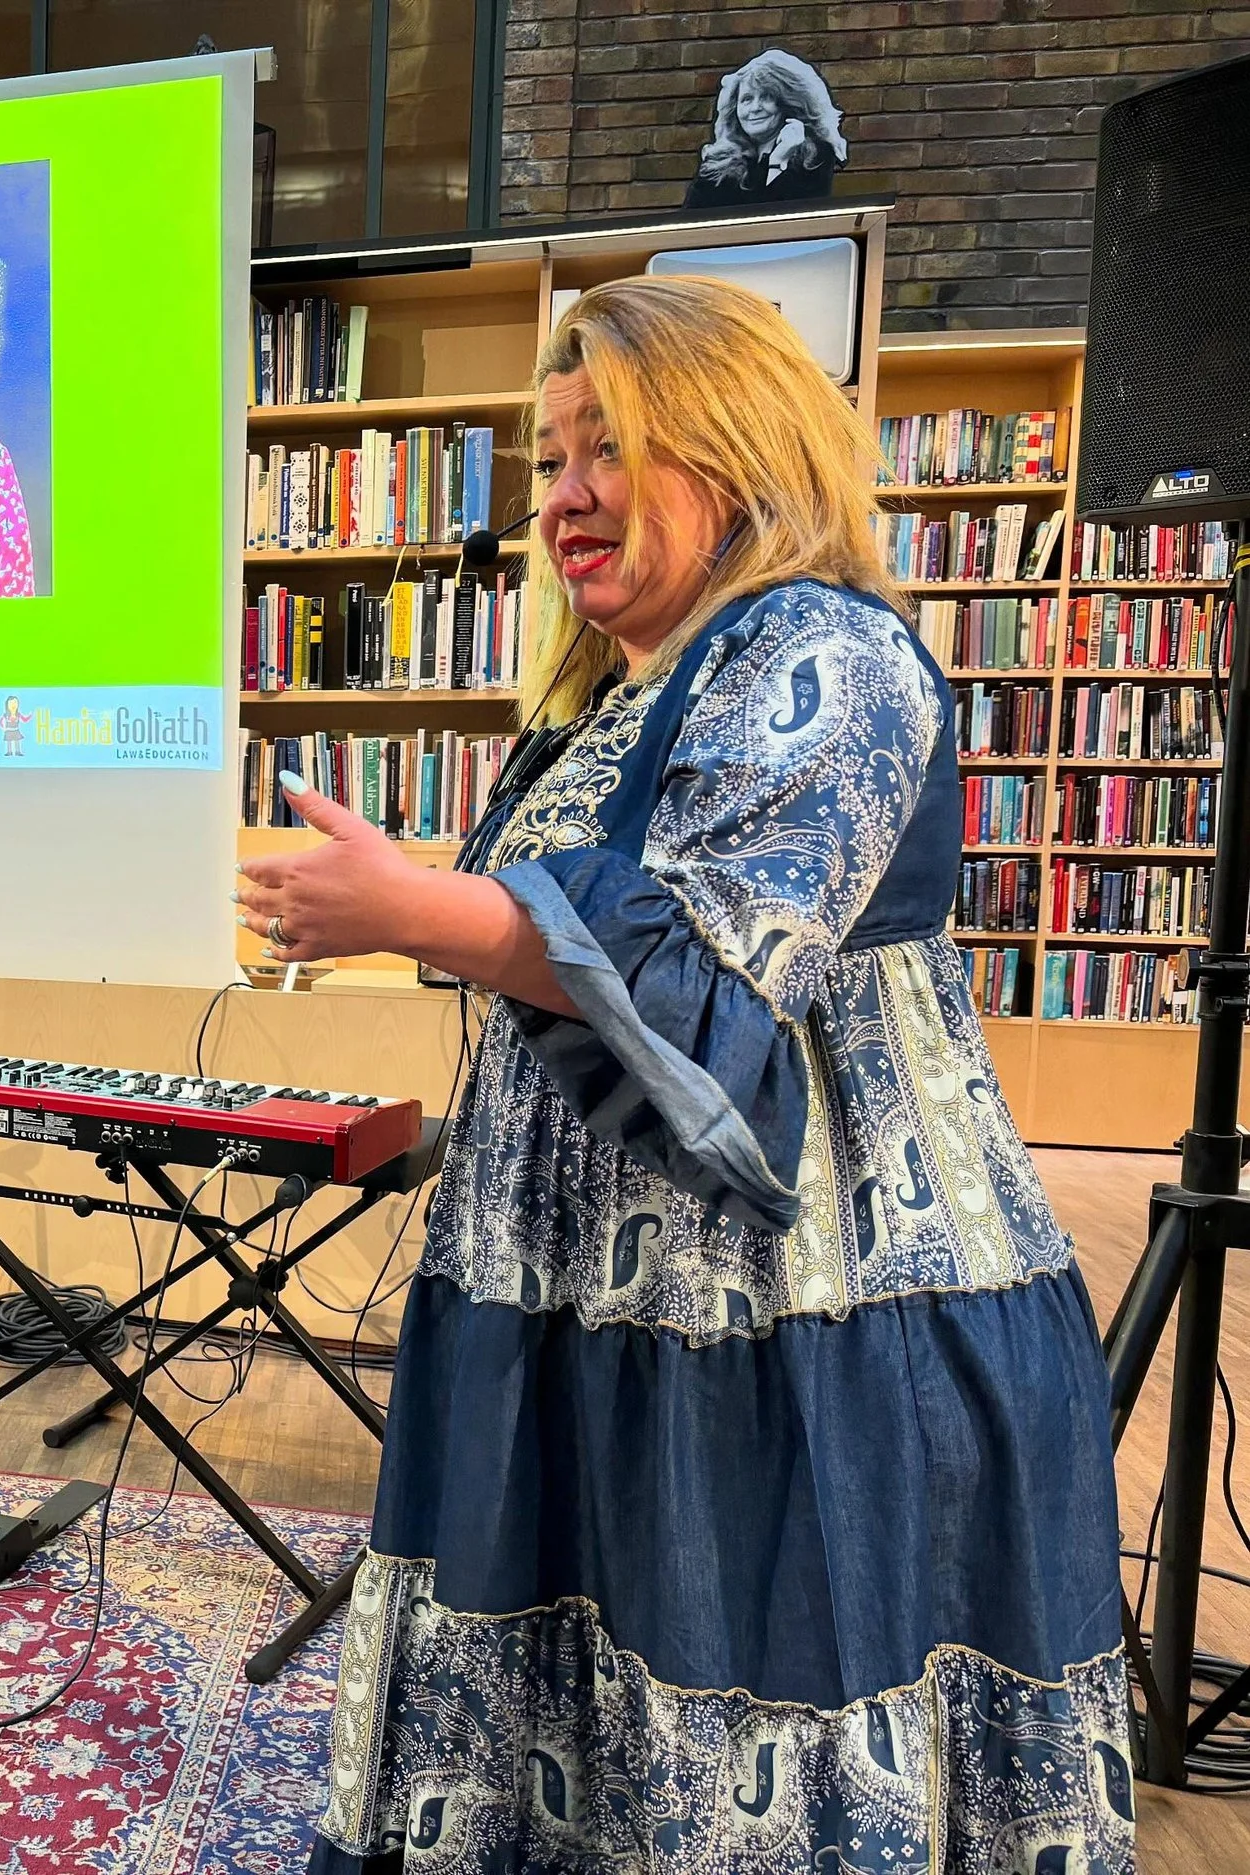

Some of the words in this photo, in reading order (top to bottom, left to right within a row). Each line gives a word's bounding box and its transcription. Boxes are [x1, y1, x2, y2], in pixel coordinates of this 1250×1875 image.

[34, 706, 113, 746] Hanna
[116, 706, 209, 746] Goliath
[364, 777, 377, 816] Ashbery
